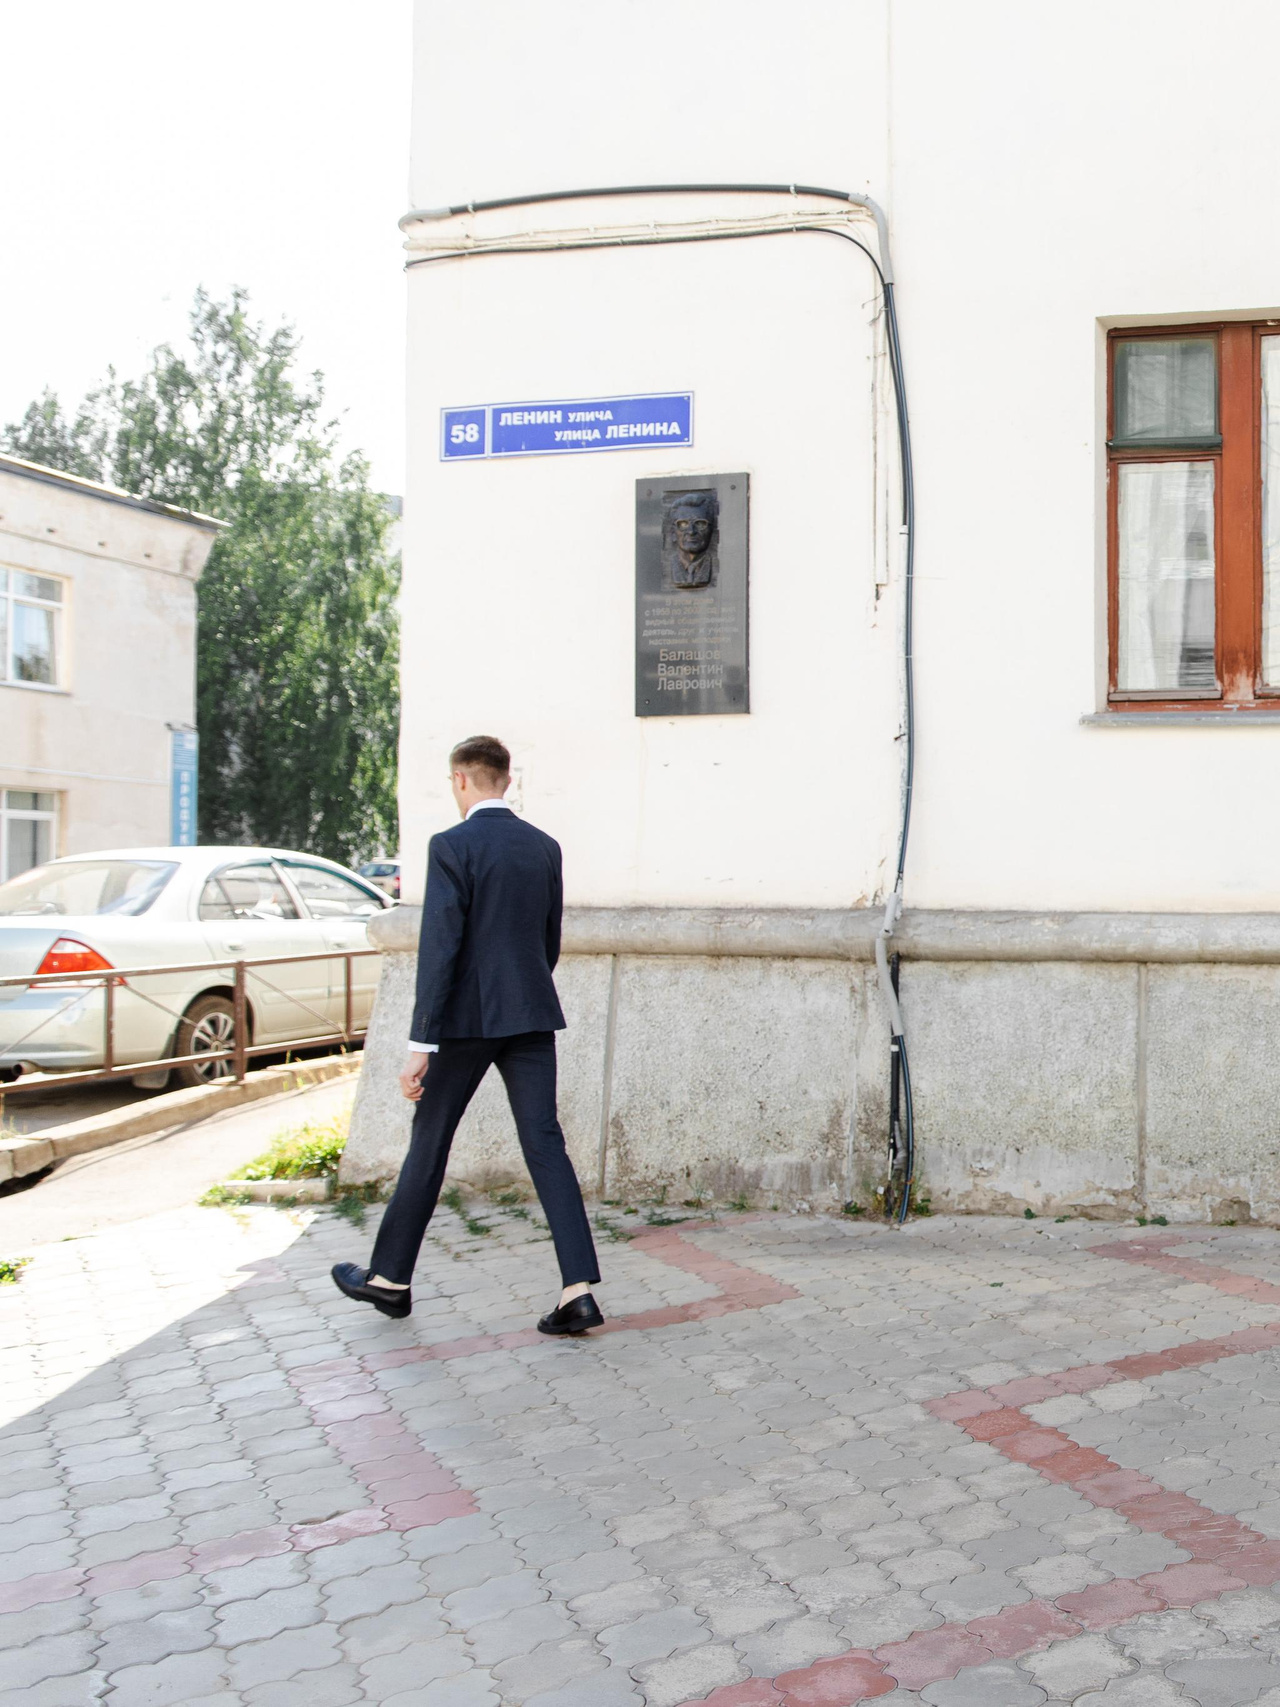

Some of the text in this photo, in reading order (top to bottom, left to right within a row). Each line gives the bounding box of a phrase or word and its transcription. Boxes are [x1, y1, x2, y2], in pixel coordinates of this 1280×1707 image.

[499, 409, 613, 426] ЛЕНИН УЛИЧА
[450, 423, 479, 444] 58
[554, 421, 681, 442] УЛИЦА ЛЕНИНА
[659, 648, 721, 662] Балашов
[657, 663, 724, 677] Валентин
[657, 677, 723, 691] Лаврович
